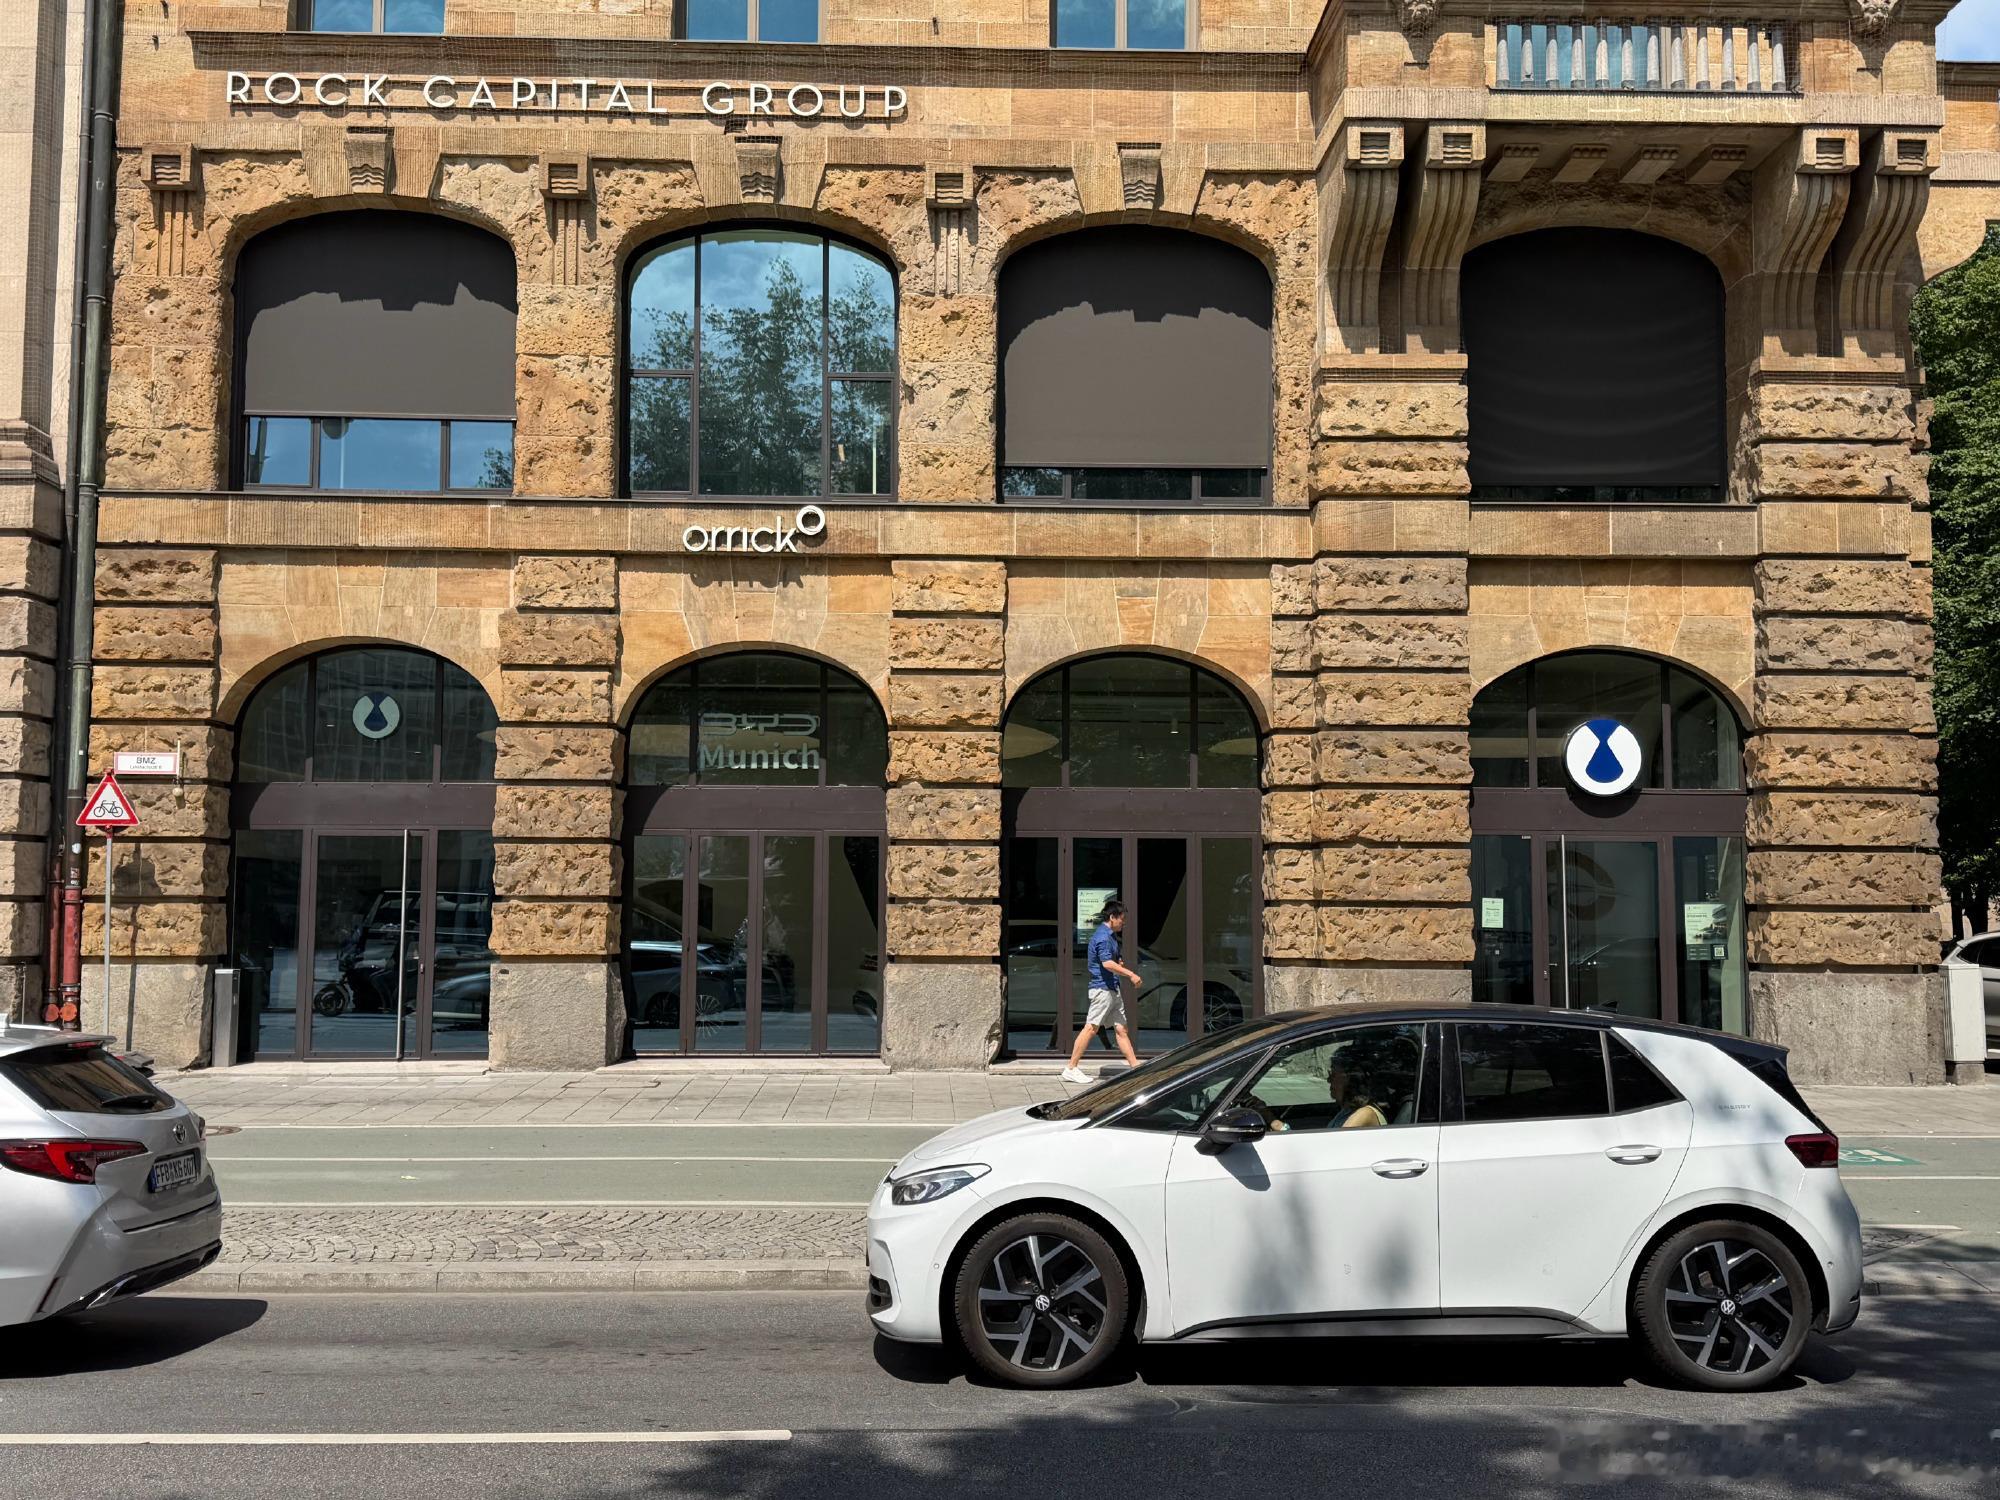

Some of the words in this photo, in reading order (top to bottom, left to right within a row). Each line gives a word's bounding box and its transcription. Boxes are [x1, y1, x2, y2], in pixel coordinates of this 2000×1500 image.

[226, 71, 389, 106] ROCK
[423, 75, 668, 113] CAPITAL
[702, 81, 907, 117] GROUP
[136, 756, 157, 765] BMZ
[697, 742, 820, 771] Munich
